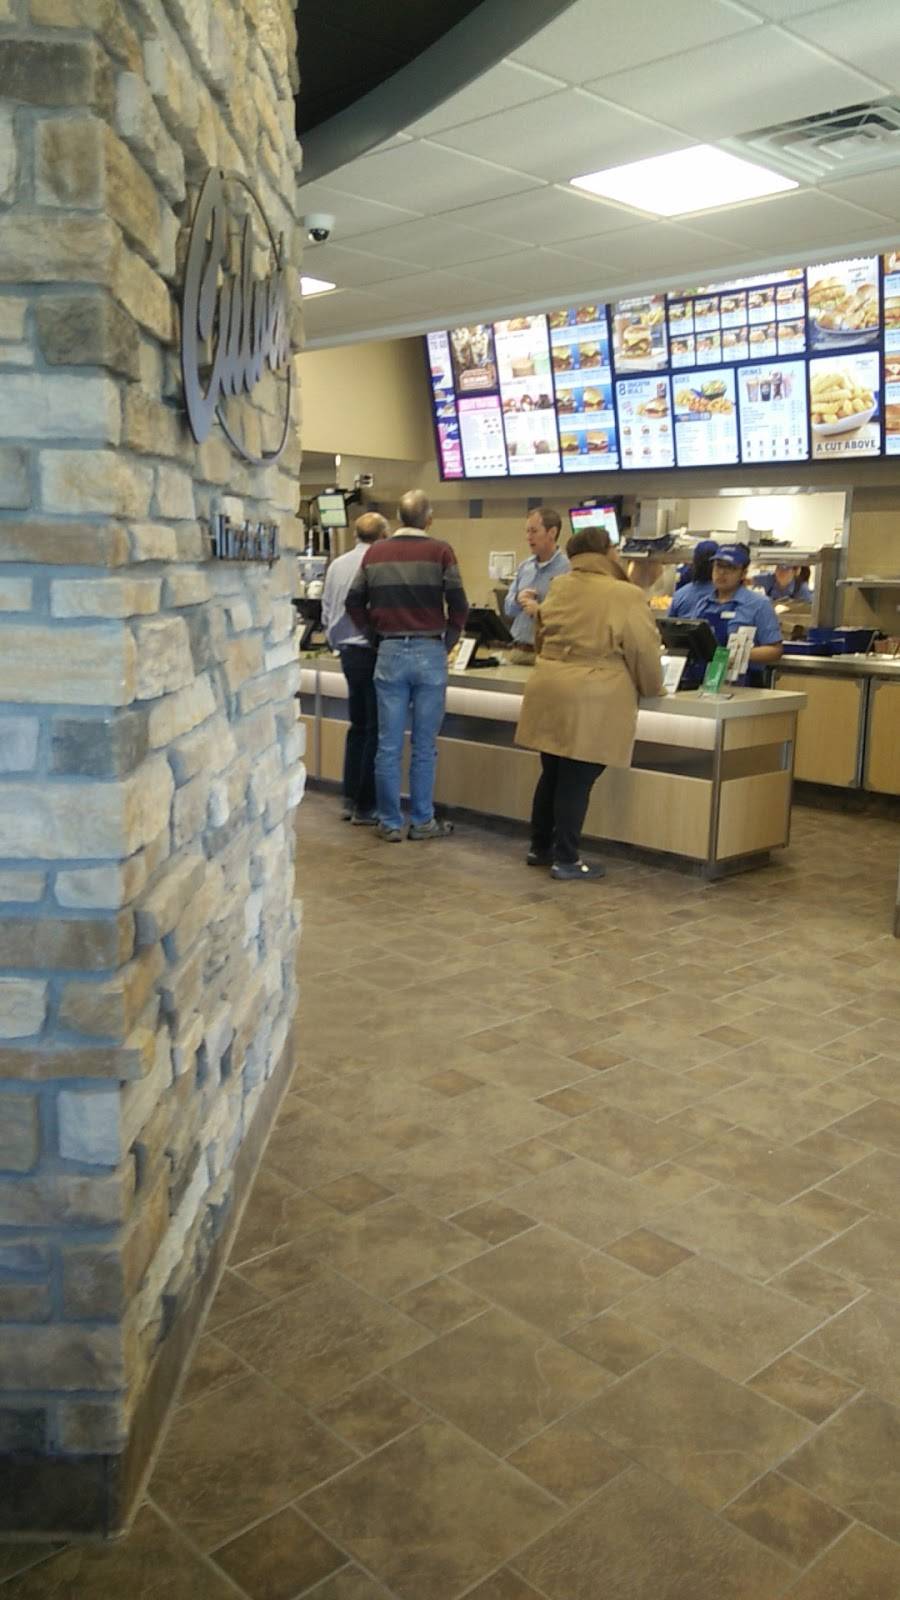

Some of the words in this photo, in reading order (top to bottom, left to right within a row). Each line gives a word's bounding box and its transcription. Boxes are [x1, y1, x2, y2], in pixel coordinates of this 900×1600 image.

[816, 443, 823, 452] A
[825, 442, 841, 451] CUT
[844, 440, 876, 450] ABOVE
